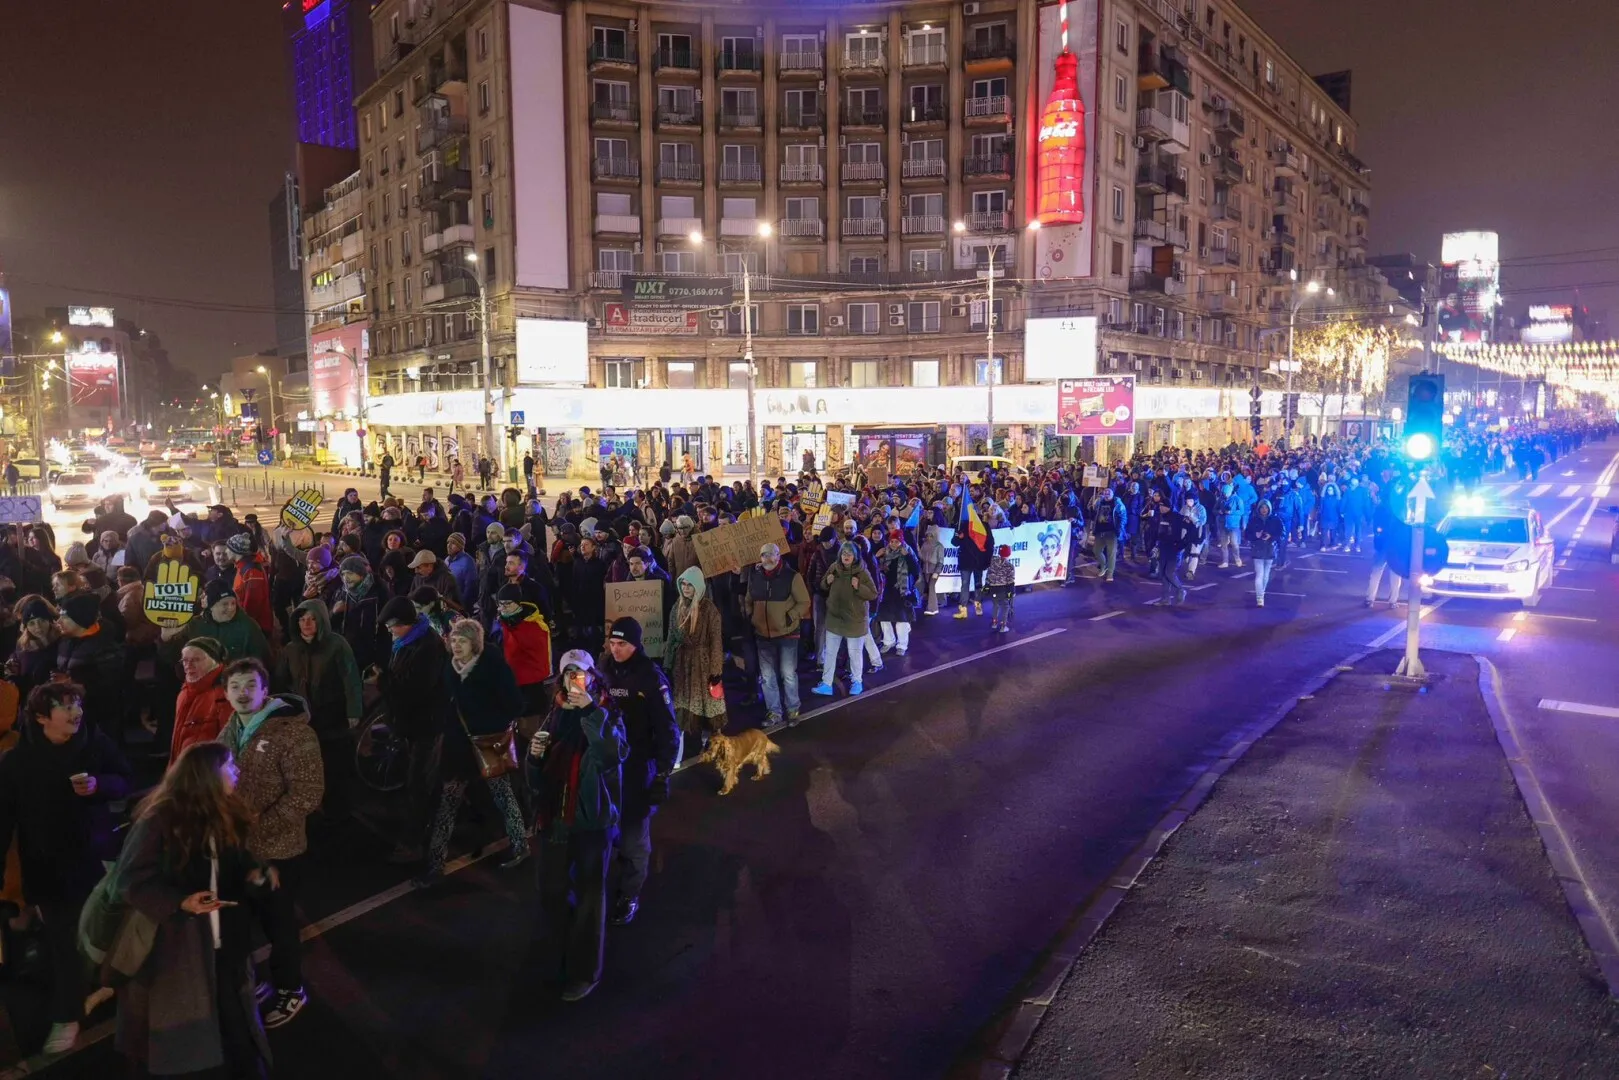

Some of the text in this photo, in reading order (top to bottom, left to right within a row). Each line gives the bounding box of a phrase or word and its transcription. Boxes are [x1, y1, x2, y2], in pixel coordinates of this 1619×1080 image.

[635, 282, 666, 294] NXT
[611, 308, 624, 322] A
[634, 314, 682, 322] traduceri
[609, 688, 628, 697] ARMERIA
